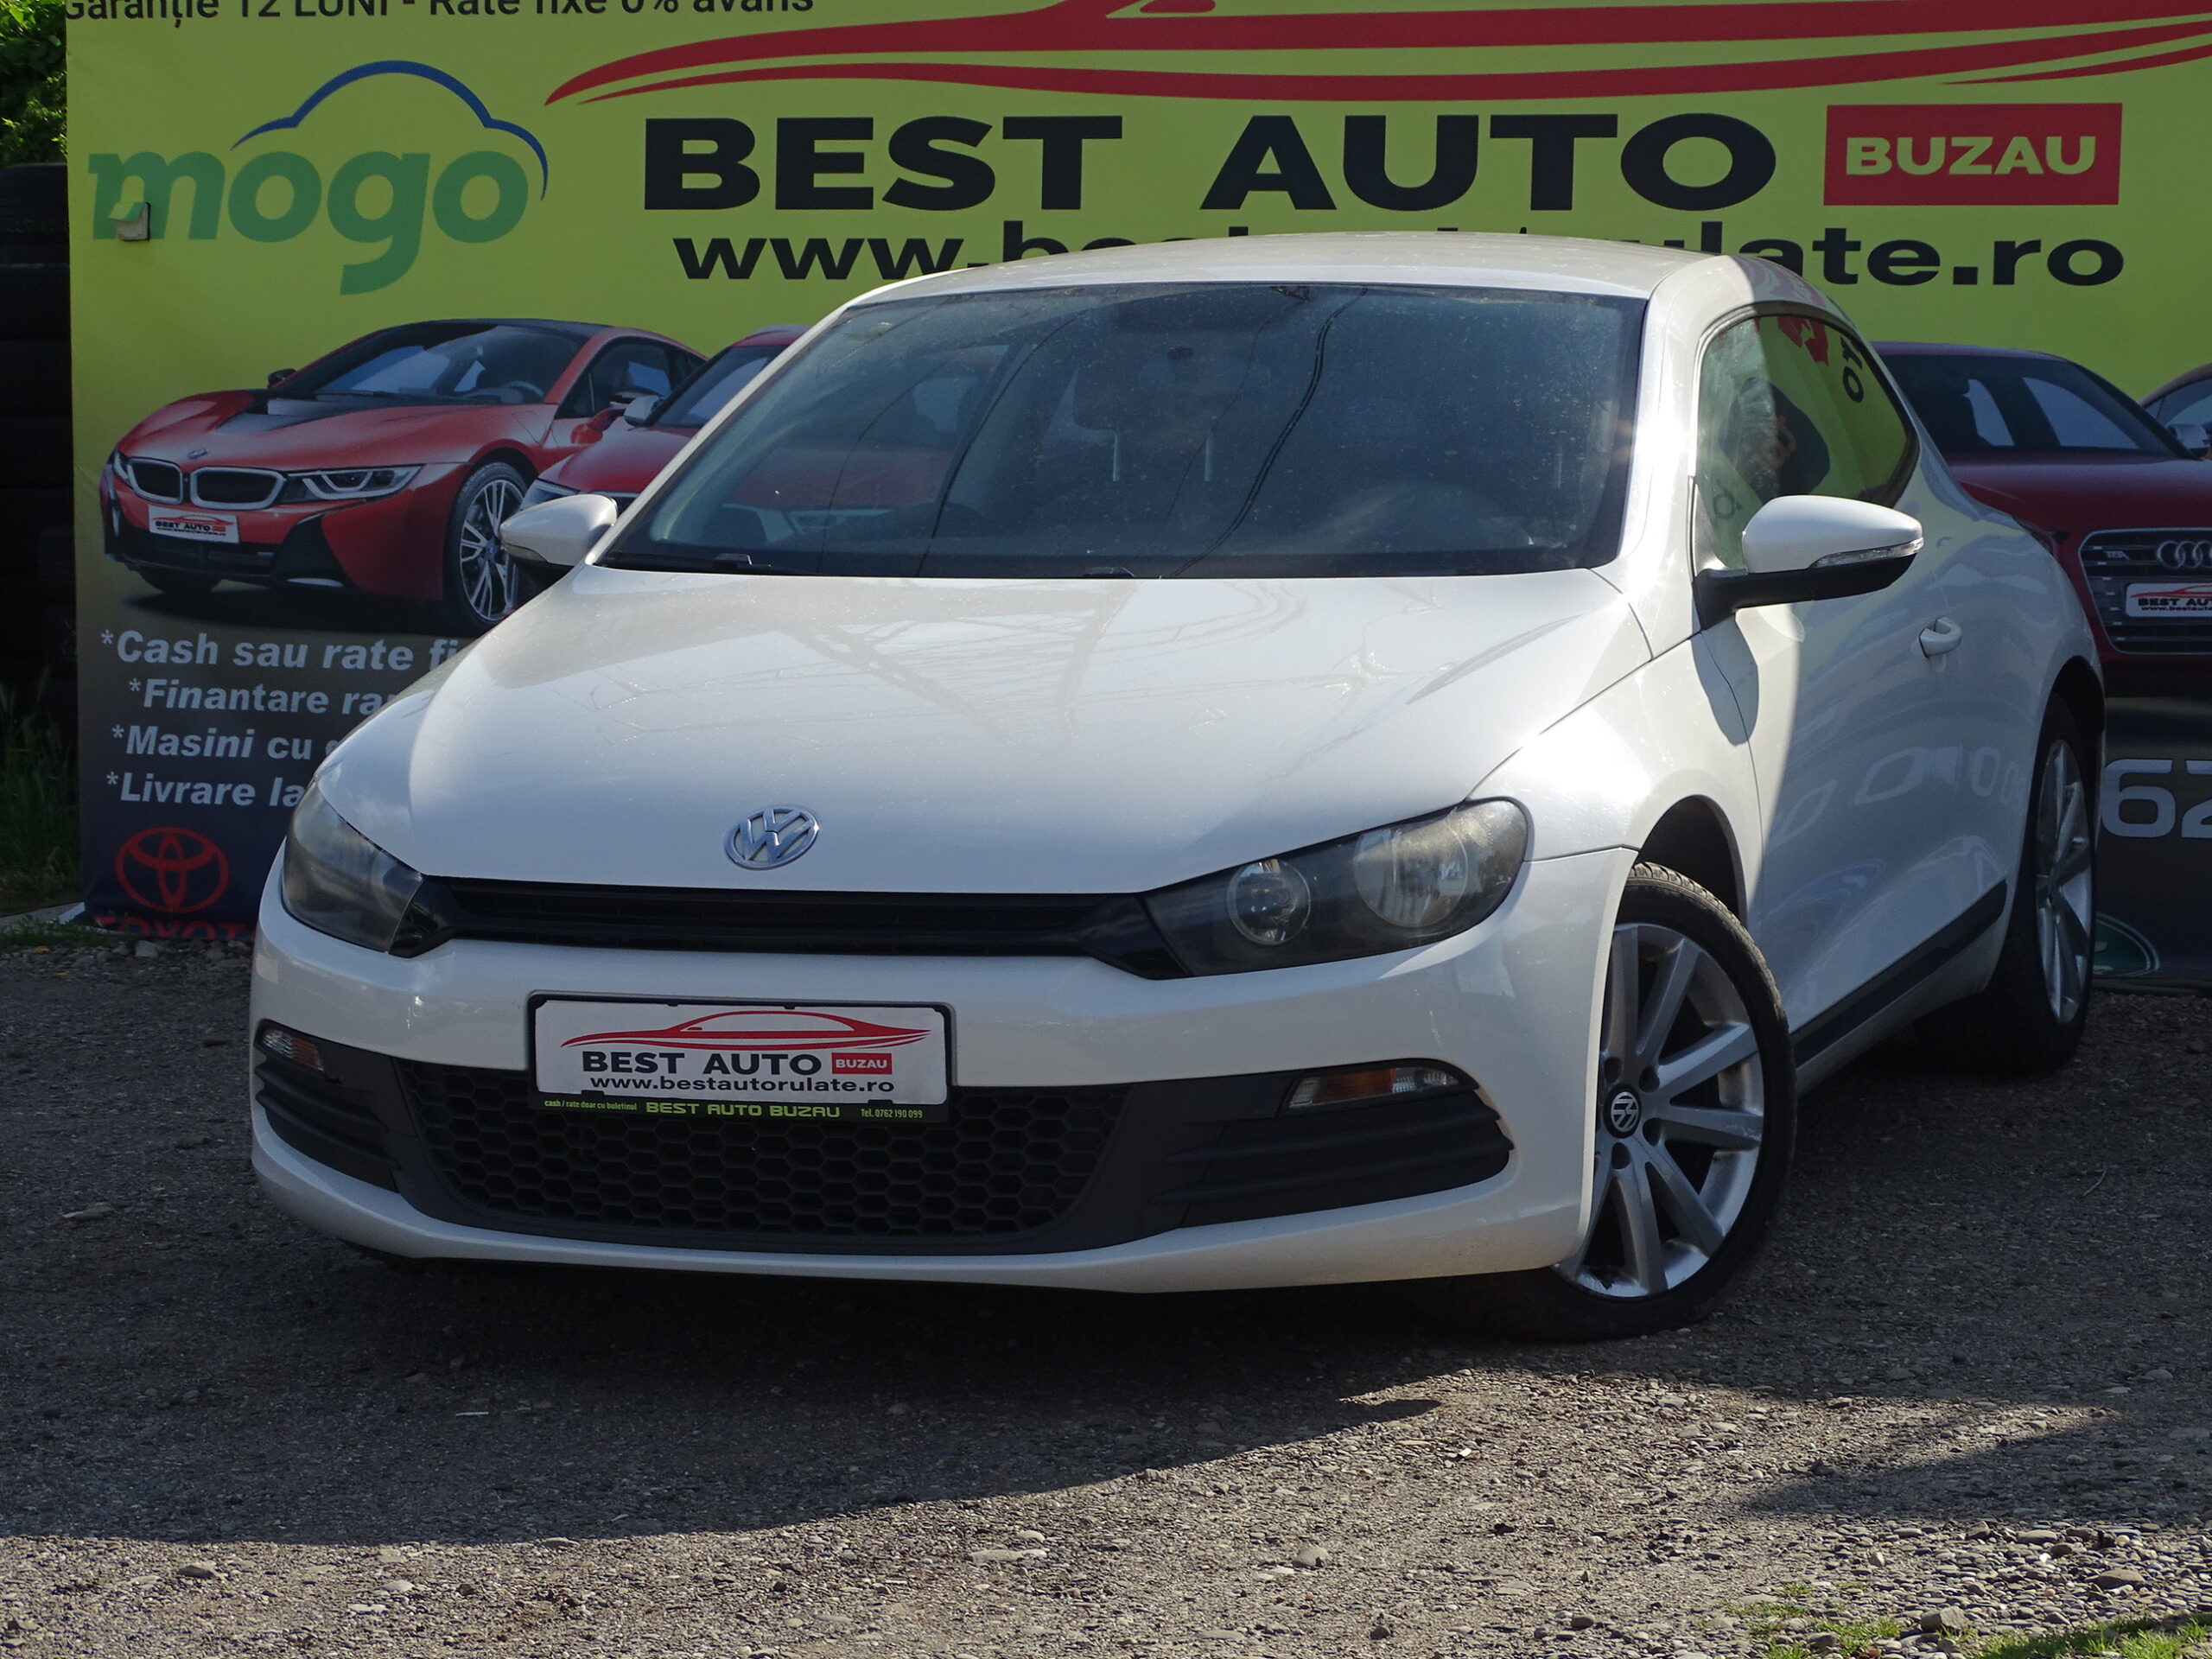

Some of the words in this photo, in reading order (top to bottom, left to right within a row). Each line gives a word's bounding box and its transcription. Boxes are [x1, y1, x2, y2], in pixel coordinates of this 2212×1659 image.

[644, 116, 1122, 212] BEST
[1200, 112, 1777, 211] AUTO
[1846, 136, 2096, 175] BUZAU
[88, 150, 529, 296] mogo
[184, 523, 211, 531] AUTO
[2138, 597, 2180, 607] BEST
[232, 642, 308, 668] sau
[321, 639, 414, 671] rate
[341, 691, 397, 715] ra
[266, 736, 312, 760] cu
[92, 915, 257, 942] OYOT
[582, 1051, 685, 1074] BEST
[702, 1052, 822, 1076] AUTO
[835, 1058, 888, 1070] BUZAU
[589, 1076, 895, 1093] www.bestautorulate.ro
[544, 1099, 561, 1108] cash
[566, 1100, 580, 1109] rate
[607, 1102, 638, 1111] buletinul
[645, 1102, 699, 1114] BEST
[707, 1103, 763, 1117] AUTO
[769, 1104, 841, 1118] BUZAU
[861, 1108, 874, 1117] Tel.
[874, 1109, 893, 1118] 0762
[894, 1109, 907, 1118] 190
[908, 1110, 923, 1119] 099
